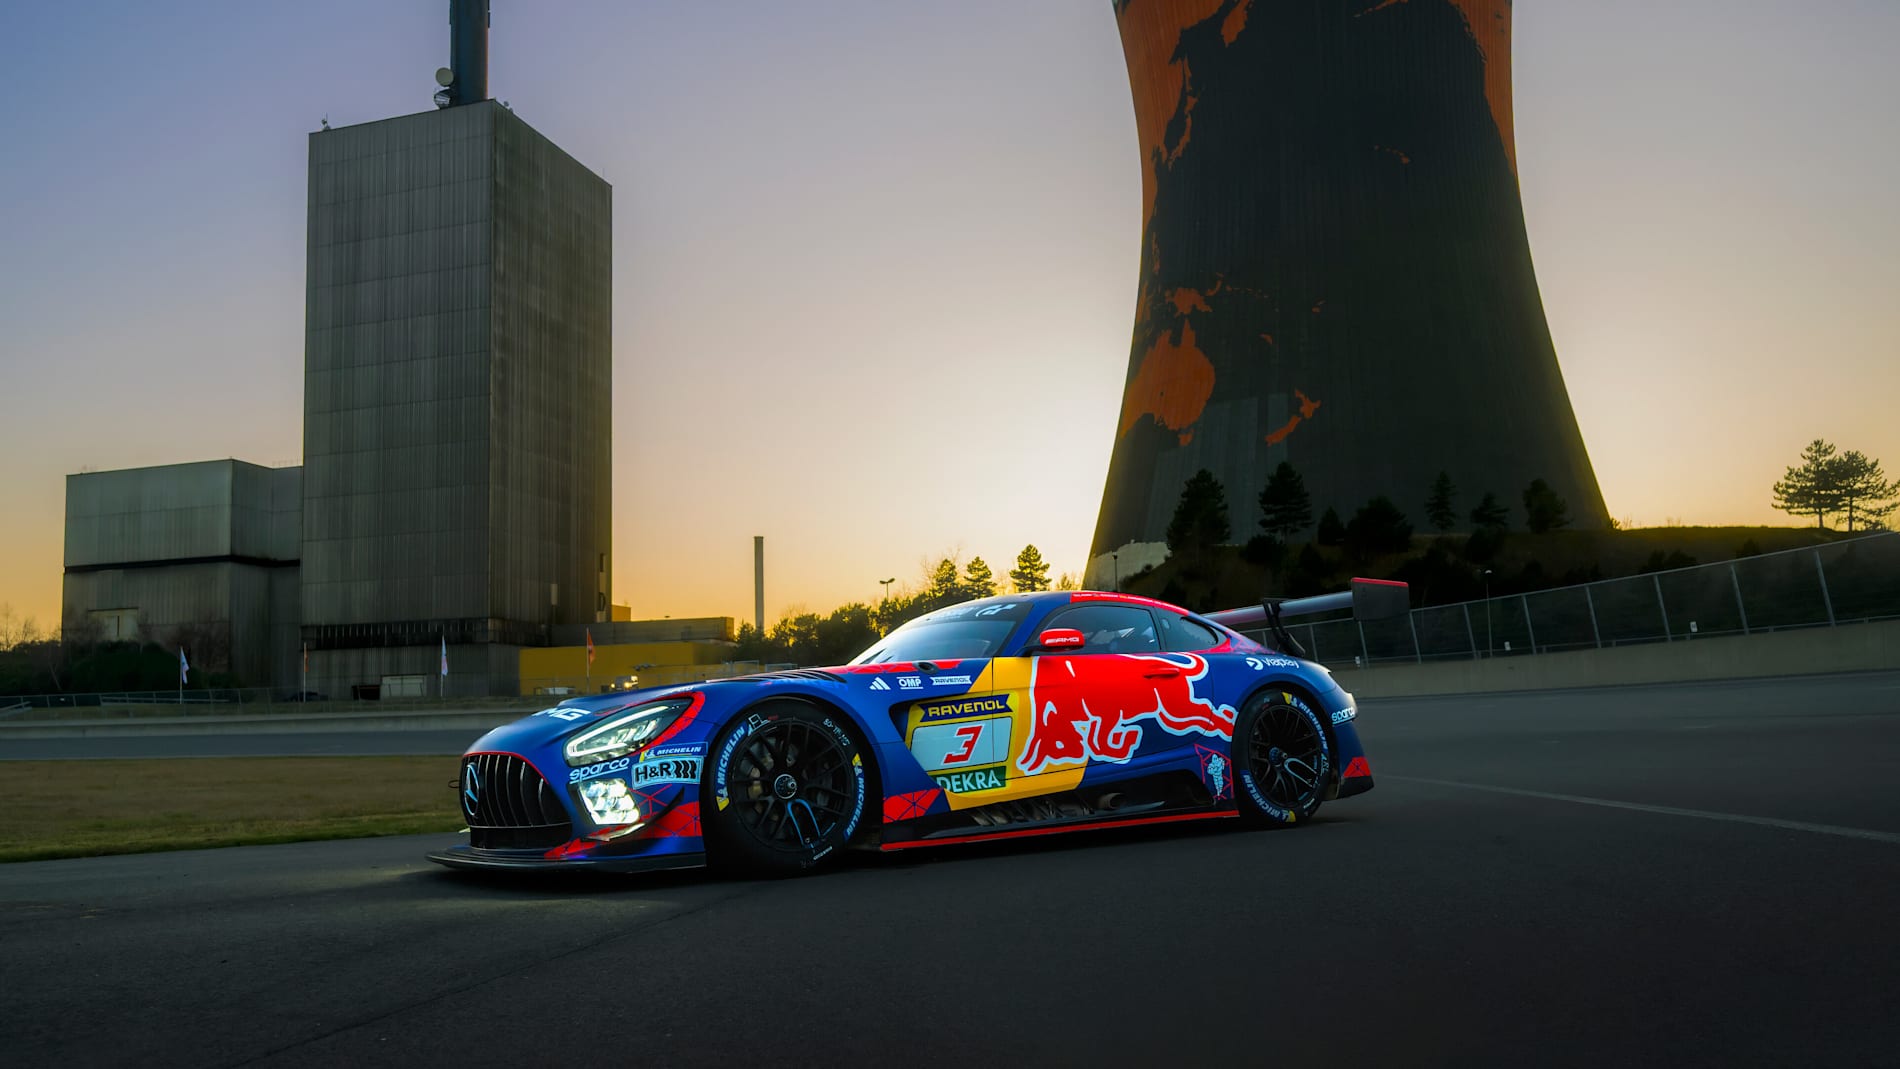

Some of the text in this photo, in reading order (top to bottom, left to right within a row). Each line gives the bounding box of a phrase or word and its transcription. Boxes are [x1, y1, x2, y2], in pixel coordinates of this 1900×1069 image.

[898, 678, 922, 688] OMP
[928, 699, 1005, 718] RAVENOL
[1298, 701, 1328, 750] MICHELIN
[657, 746, 702, 755] MICHELIN
[717, 726, 745, 785] MICHELIN
[942, 723, 985, 765] 3
[569, 757, 630, 783] sparco
[634, 762, 672, 783] H&R
[936, 768, 1002, 793] DEKRA
[846, 775, 865, 837] MICHELIN
